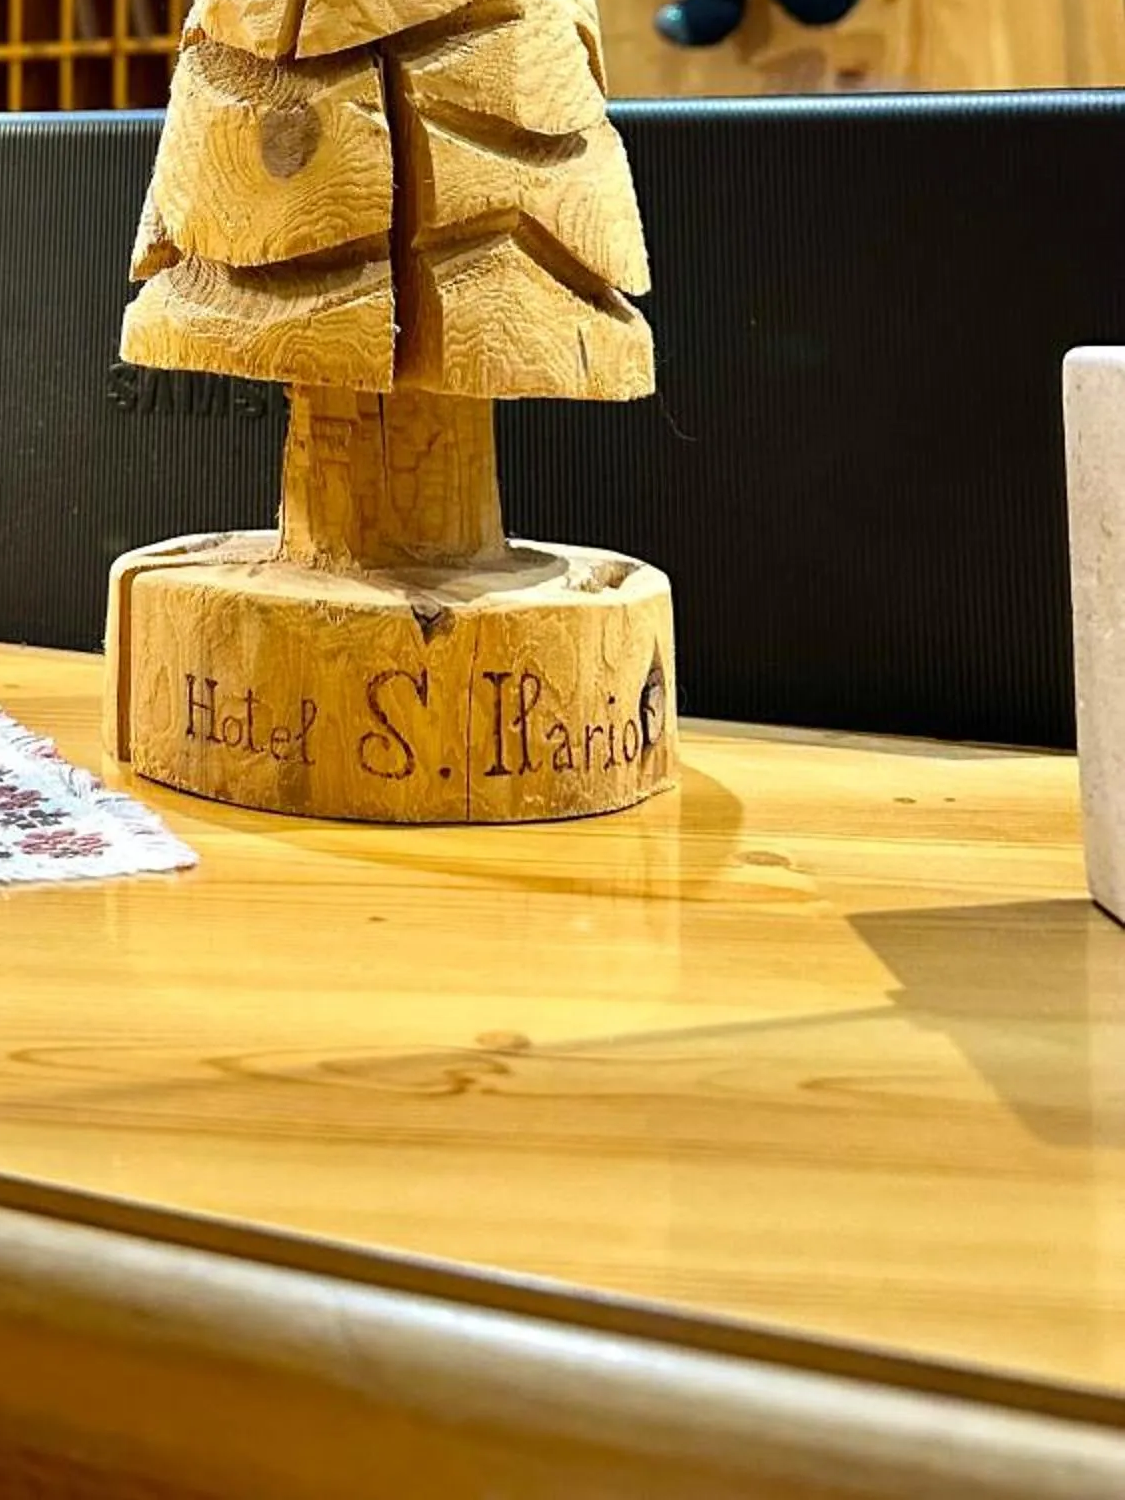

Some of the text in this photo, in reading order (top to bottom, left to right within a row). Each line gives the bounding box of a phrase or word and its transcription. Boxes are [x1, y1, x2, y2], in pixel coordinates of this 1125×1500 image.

[185, 667, 639, 779] Hotel S. Ilario
